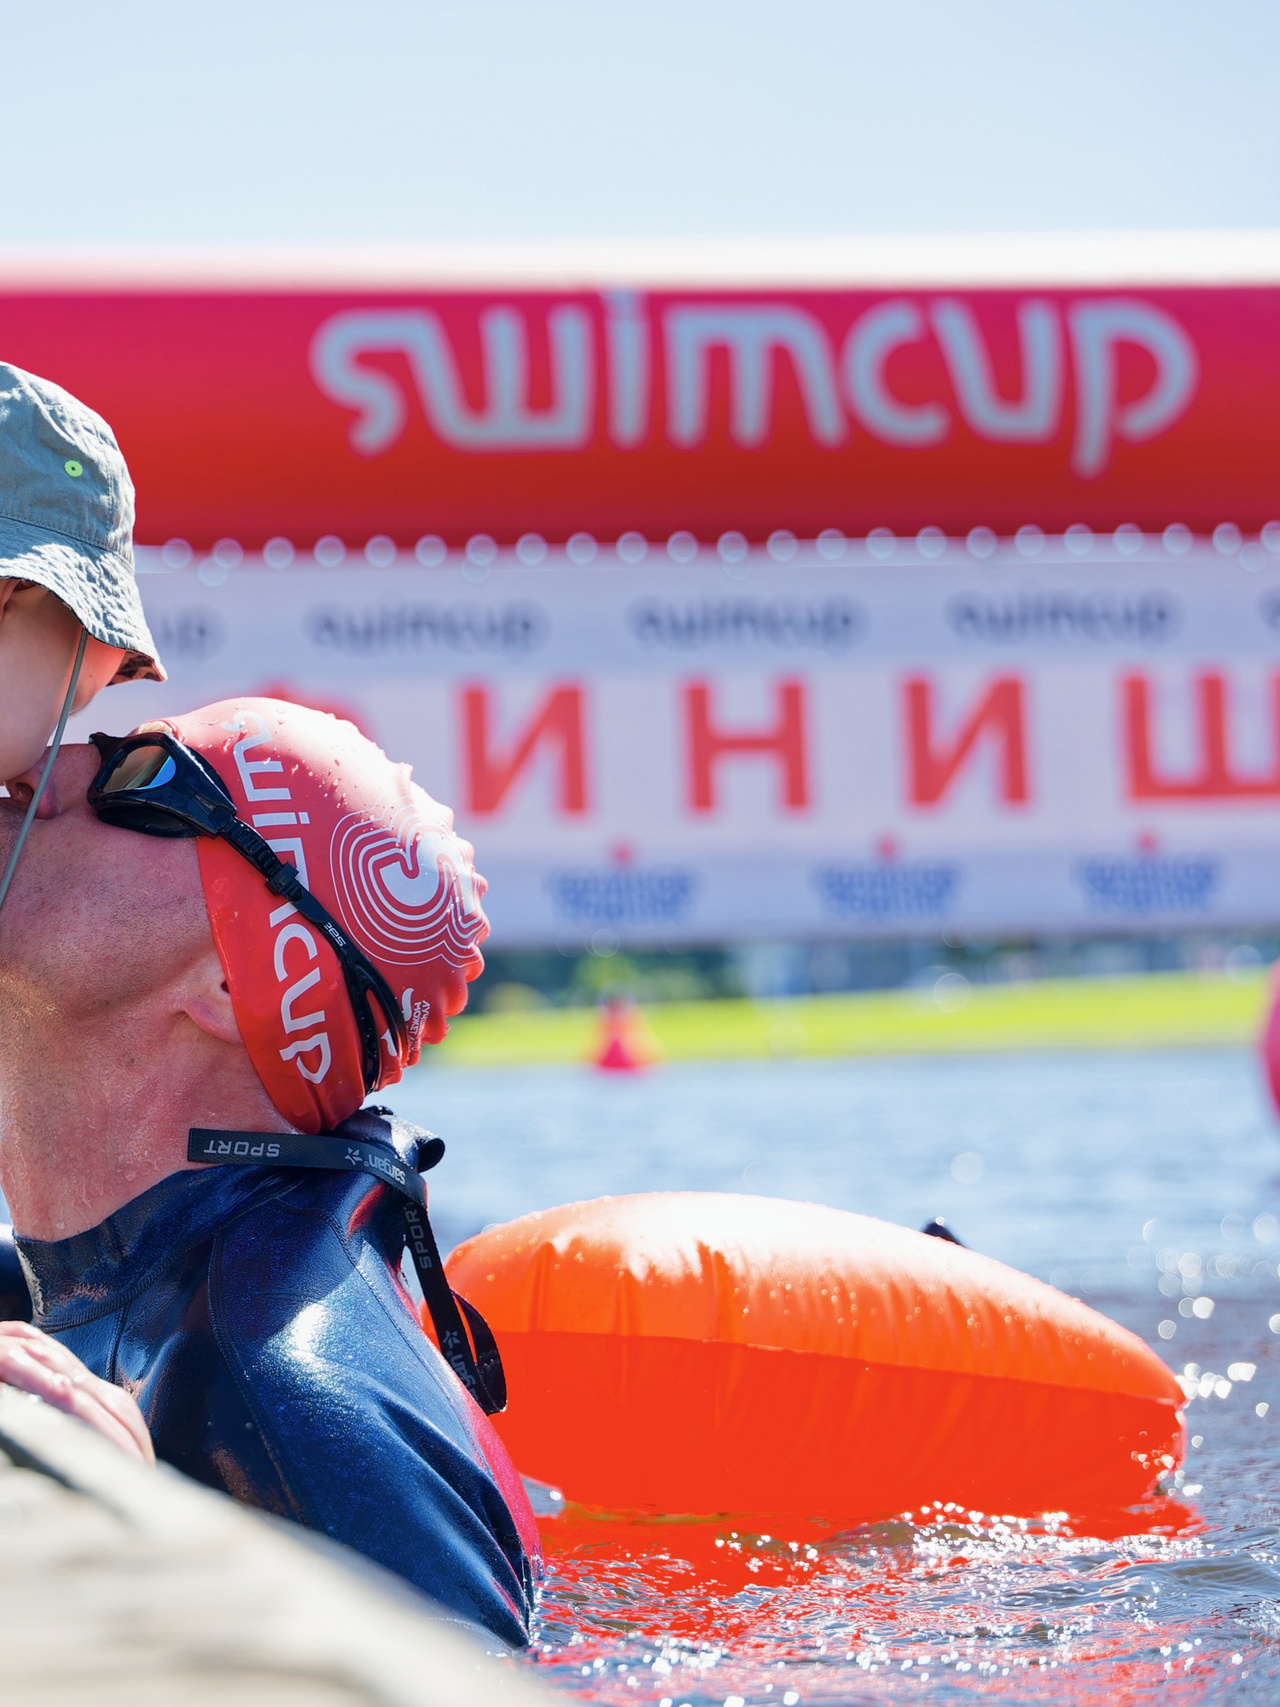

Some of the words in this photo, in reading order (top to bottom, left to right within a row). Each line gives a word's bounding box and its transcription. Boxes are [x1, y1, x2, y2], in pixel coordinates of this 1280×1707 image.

[310, 292, 1200, 477] swimcup
[240, 668, 1280, 818] ИНИШ
[221, 710, 333, 1085] swimcup
[409, 1001, 422, 1035] МОЖЕТ
[204, 1139, 281, 1158] SPORT
[368, 1153, 406, 1186] sargan
